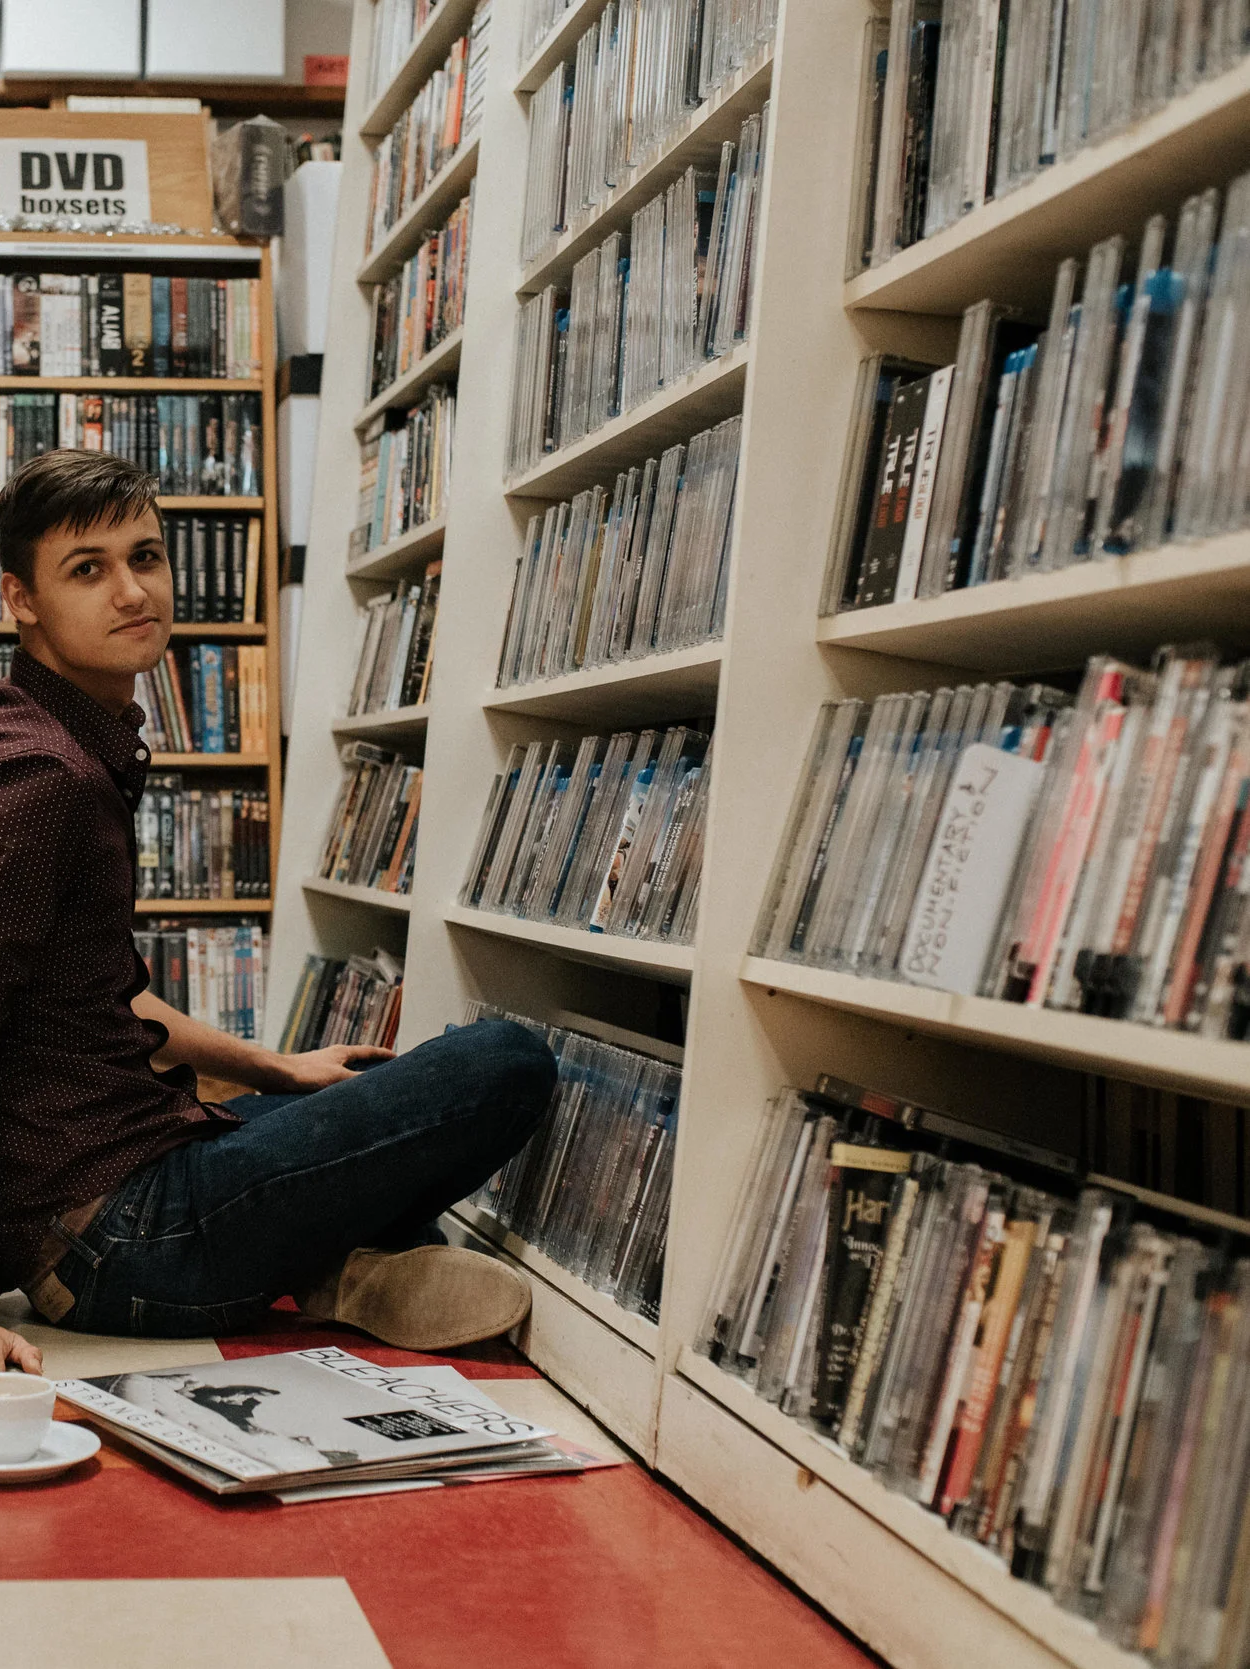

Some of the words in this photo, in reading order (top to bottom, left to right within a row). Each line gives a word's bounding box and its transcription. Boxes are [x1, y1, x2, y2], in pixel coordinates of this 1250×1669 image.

[20, 152, 124, 191] DVD
[20, 195, 127, 216] boxsets
[132, 350, 145, 366] 2
[907, 808, 964, 974] DOCUMENTARY
[925, 766, 999, 975] NON-FICTION
[55, 1381, 166, 1429] STRANGE
[299, 1350, 535, 1437] BLEACHERS
